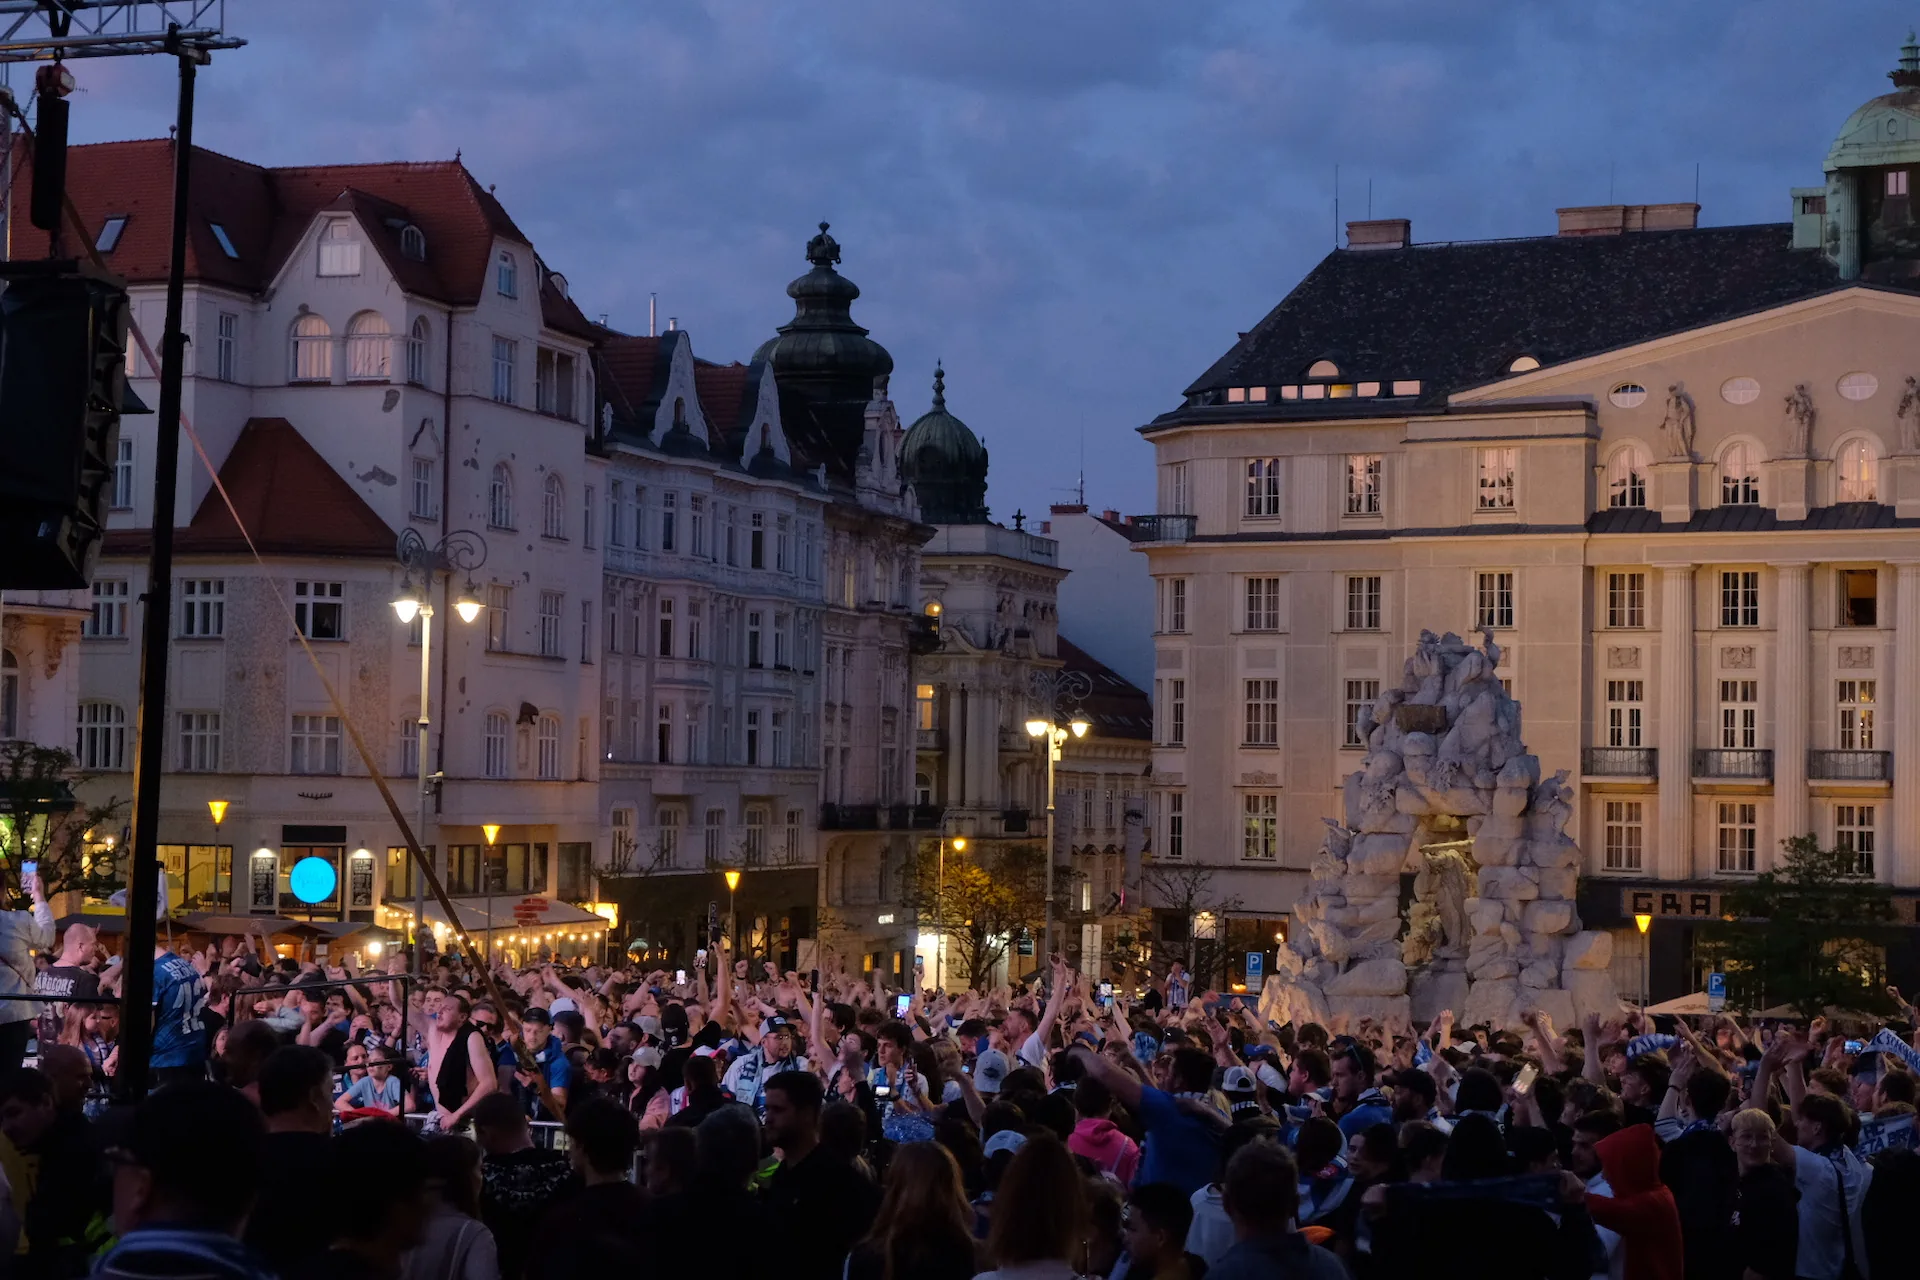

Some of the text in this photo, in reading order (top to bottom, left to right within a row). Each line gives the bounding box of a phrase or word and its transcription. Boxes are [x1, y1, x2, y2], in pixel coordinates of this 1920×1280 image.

[1633, 892, 1711, 915] GRA
[1249, 955, 1260, 969] P
[1711, 975, 1723, 990] P
